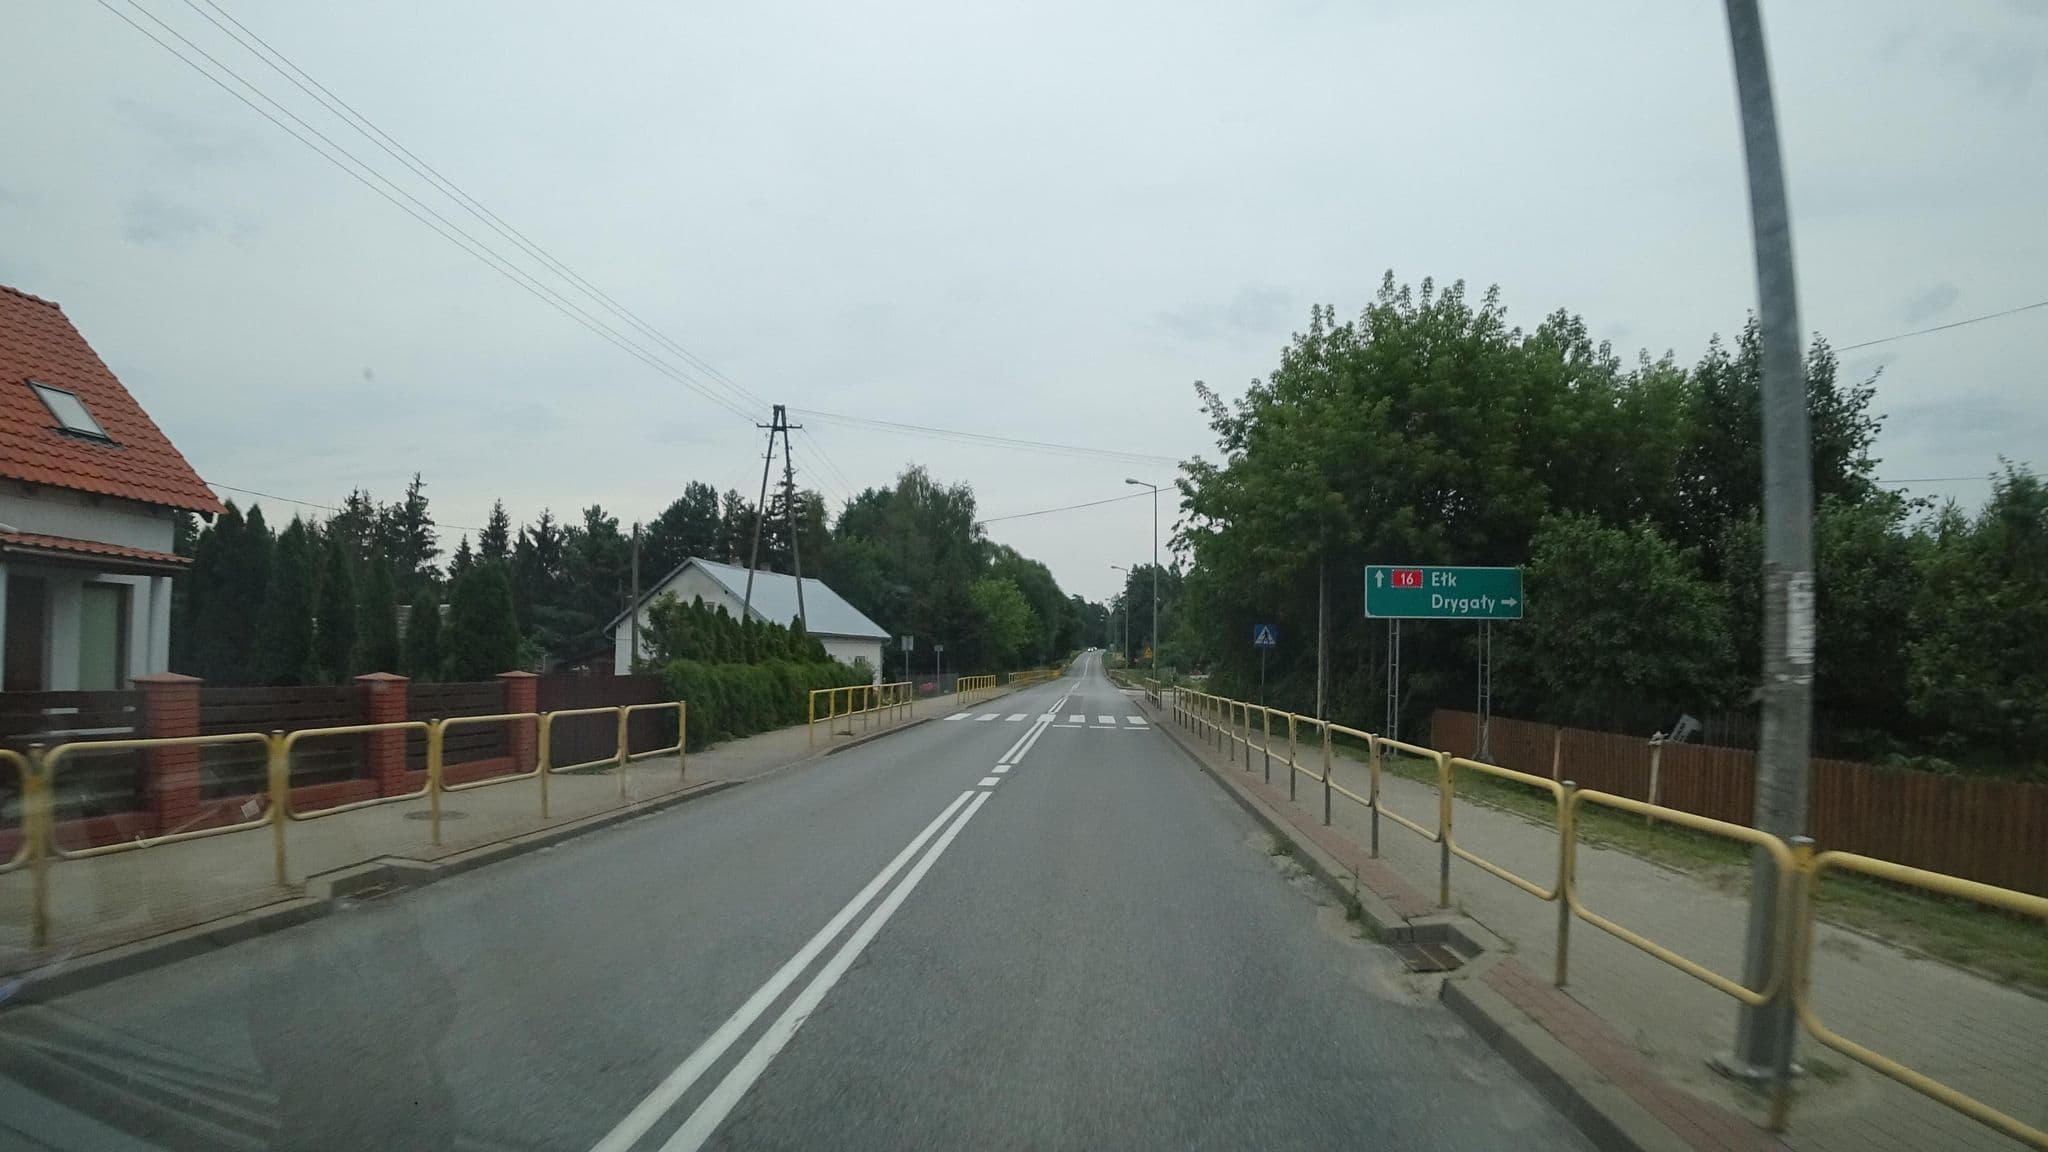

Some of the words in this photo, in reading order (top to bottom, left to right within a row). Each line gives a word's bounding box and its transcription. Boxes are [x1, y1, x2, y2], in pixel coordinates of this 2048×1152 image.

[1400, 573, 1414, 585] 16
[1431, 571, 1457, 587] Ełk
[1431, 594, 1496, 613] Drygały
